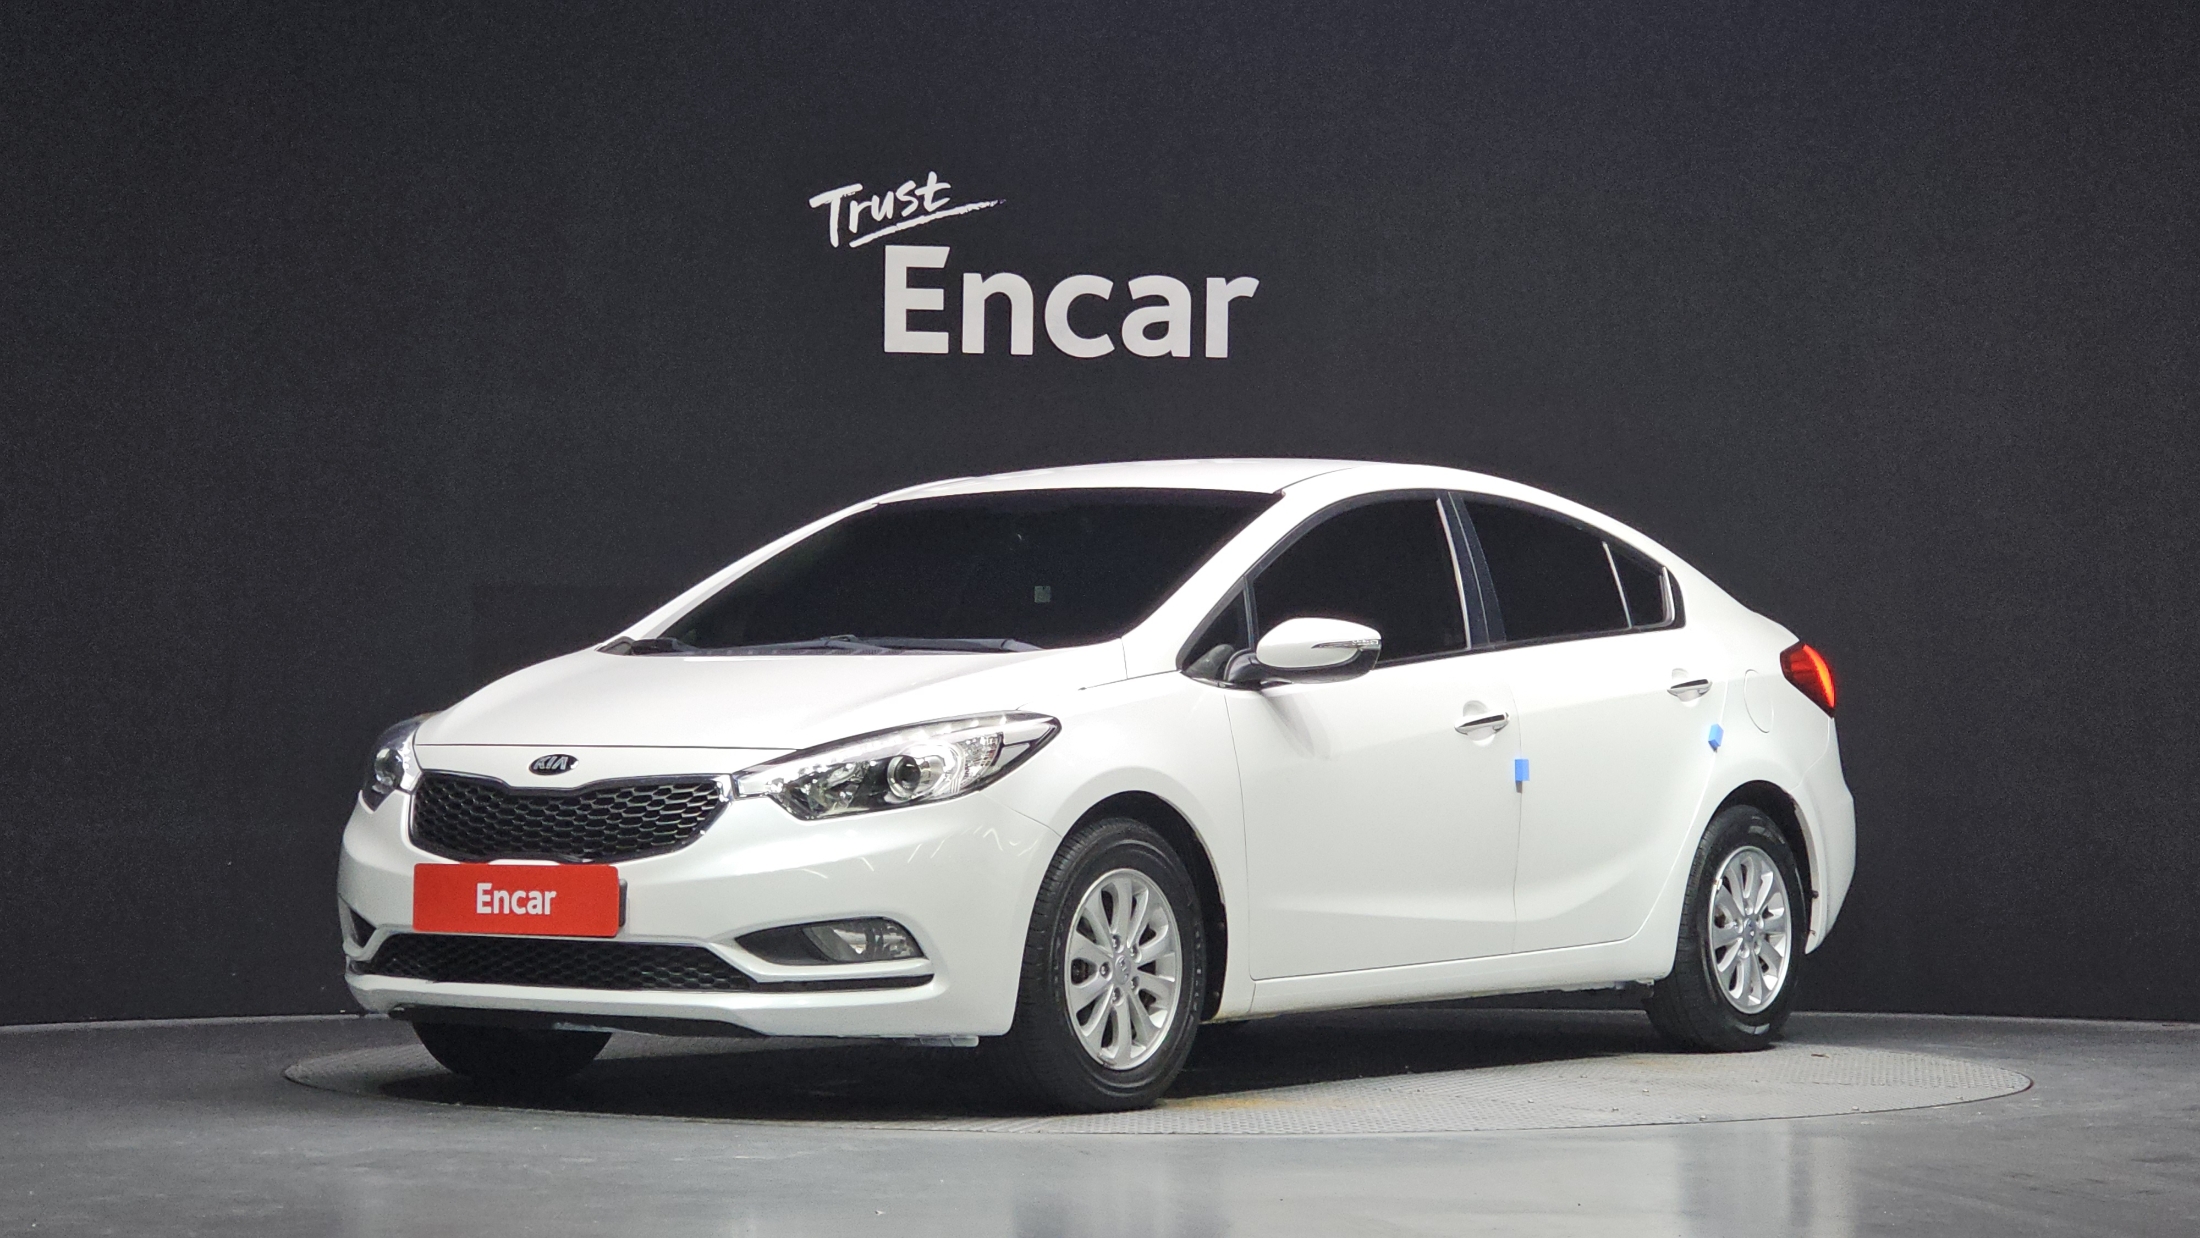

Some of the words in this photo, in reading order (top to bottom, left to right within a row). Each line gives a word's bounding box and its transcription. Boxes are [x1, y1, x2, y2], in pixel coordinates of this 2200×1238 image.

[808, 170, 952, 248] Trust
[884, 245, 1260, 358] Encar
[532, 755, 569, 770] KIA
[476, 882, 557, 915] Encar
